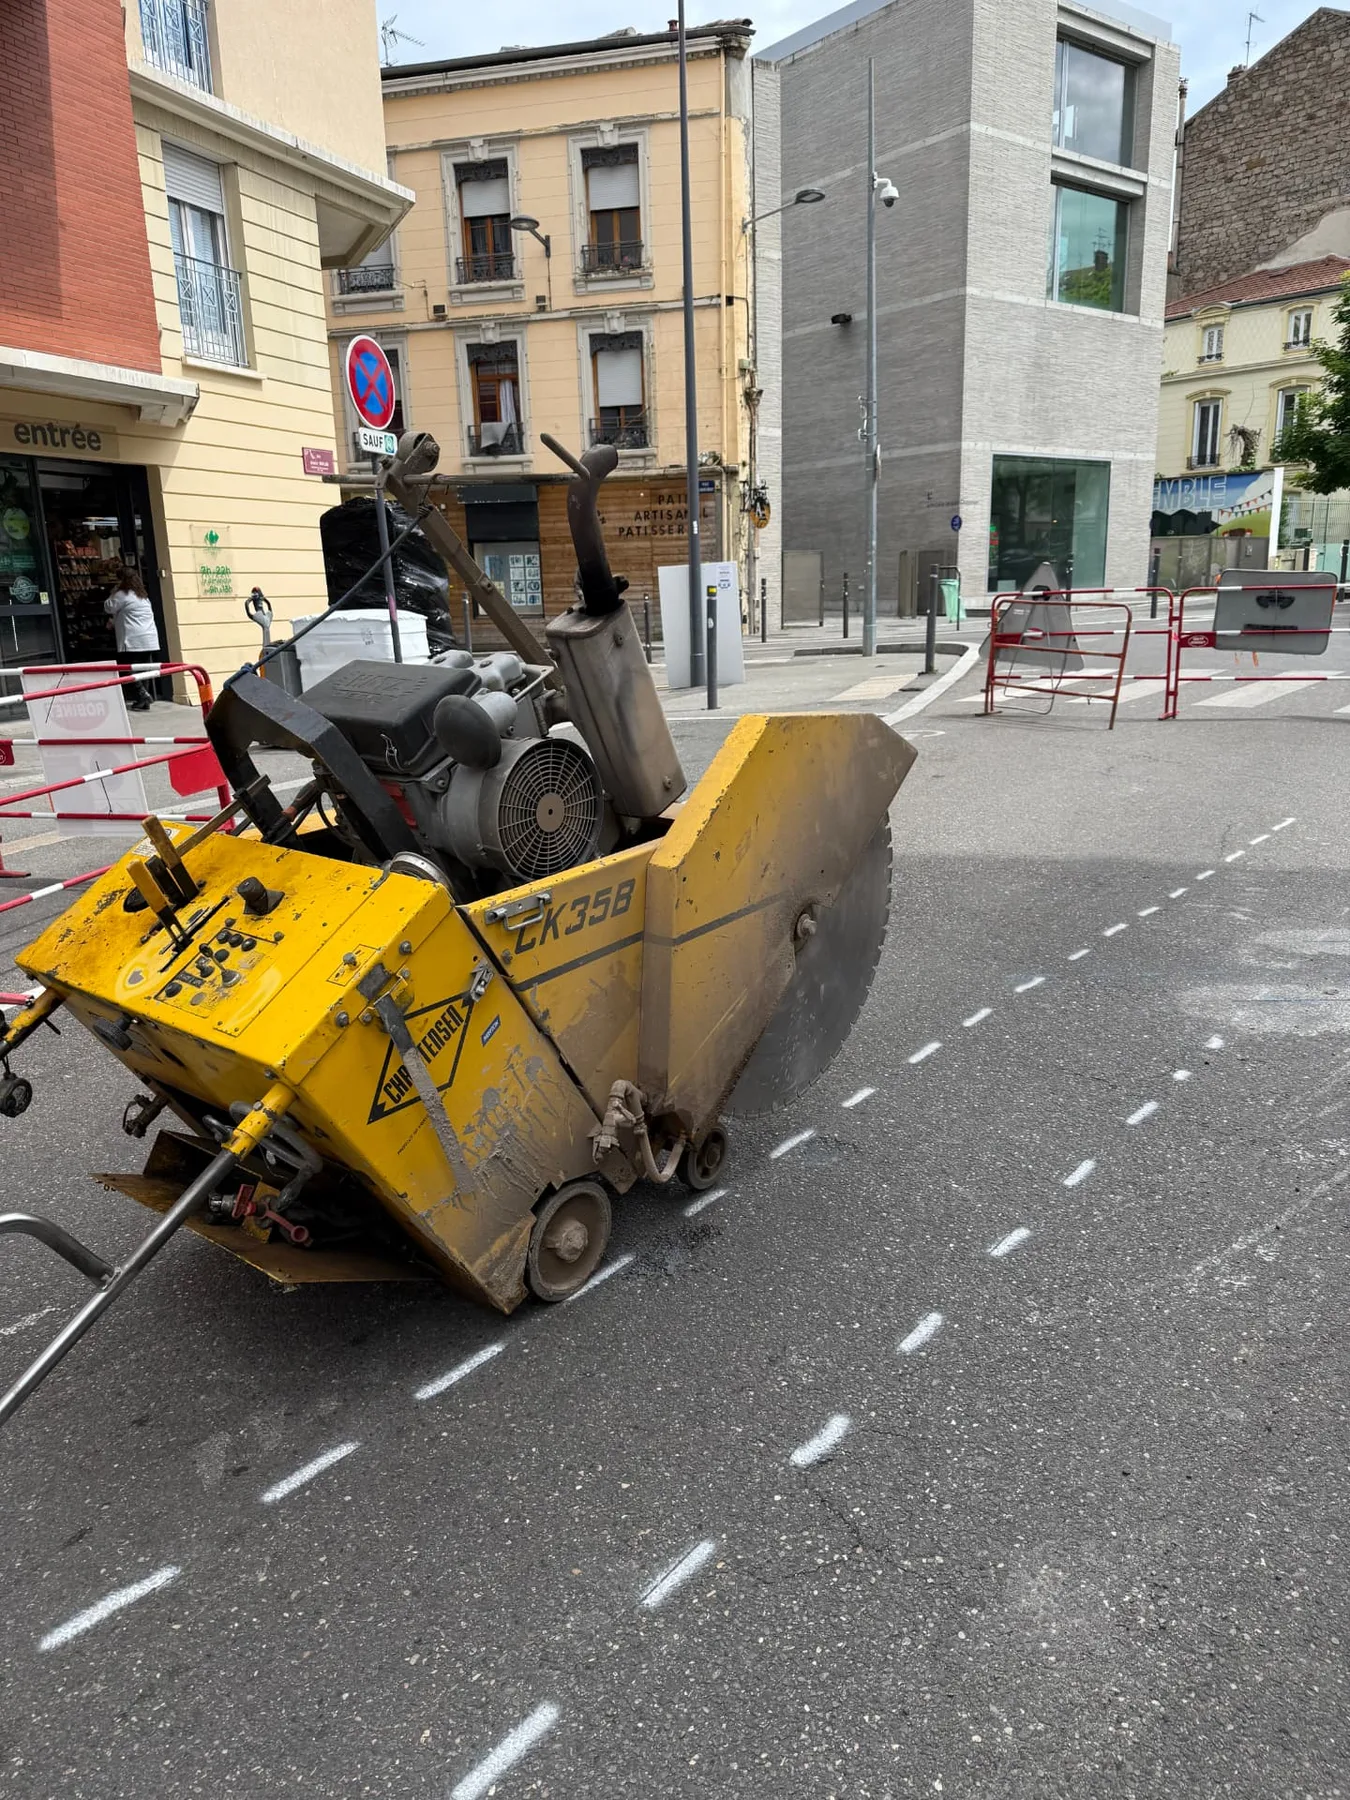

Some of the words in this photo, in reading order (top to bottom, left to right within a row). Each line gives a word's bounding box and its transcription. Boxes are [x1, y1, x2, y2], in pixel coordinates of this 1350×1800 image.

[14, 421, 102, 452] entrée
[362, 433, 384, 449] SAUF
[658, 494, 688, 505] PAI
[634, 507, 709, 522] ARTISAL
[618, 524, 685, 537] PATISSER
[383, 1004, 465, 1105] CHRTENSEN
